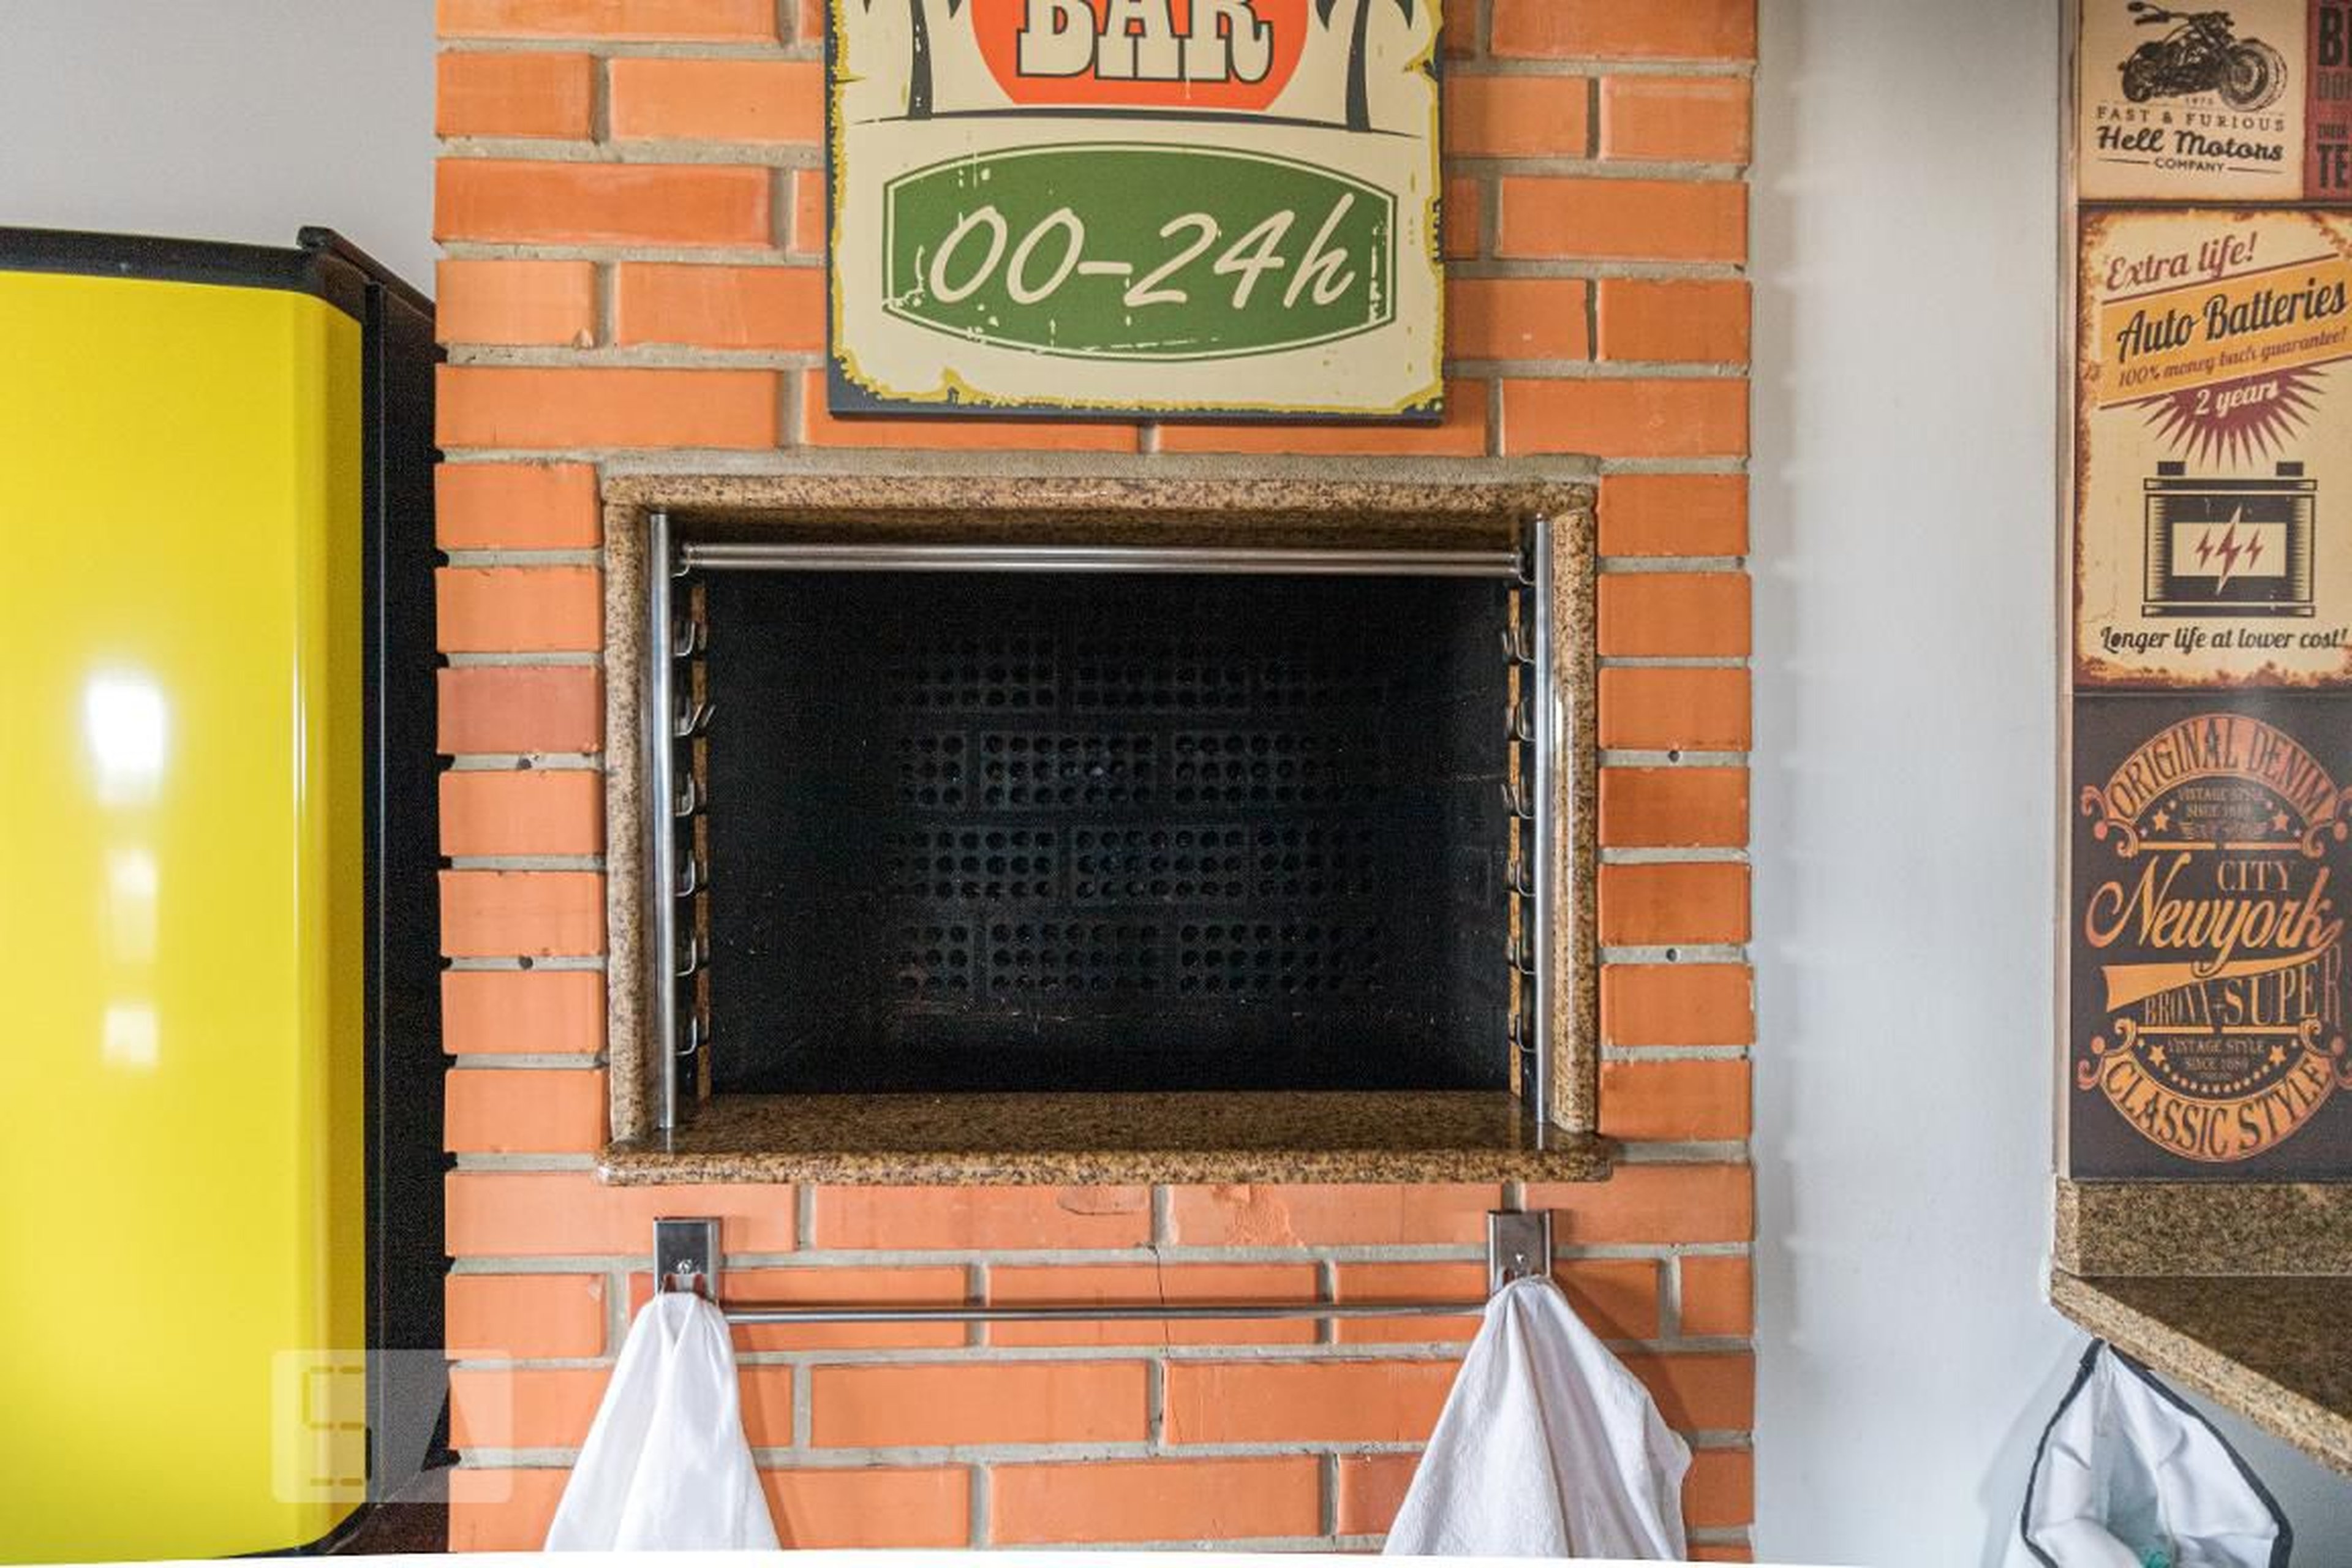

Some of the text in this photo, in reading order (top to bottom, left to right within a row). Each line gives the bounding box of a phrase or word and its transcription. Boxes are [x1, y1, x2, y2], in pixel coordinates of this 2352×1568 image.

[1016, 0, 1274, 84] BAR
[2097, 105, 2285, 132] FAST & FURIOUS
[2097, 126, 2165, 153] Hell
[2174, 130, 2283, 162] Motors
[2155, 157, 2226, 173] COMPANY
[929, 192, 1357, 310] 00-24h
[2106, 231, 2258, 291] Extra life!
[2117, 277, 2346, 364] Auto Batteries
[2119, 368, 2160, 387] 100%
[2164, 357, 2215, 375] money
[2219, 349, 2257, 367] back
[2195, 380, 2279, 415] 2 years
[2101, 626, 2348, 654] Longer life at lower cost!
[2109, 716, 2239, 819] ORIGINAL
[2217, 860, 2290, 892] CITY
[2086, 851, 2344, 978] Newyork
[2106, 1057, 2327, 1156] CLASSIC STYLE
